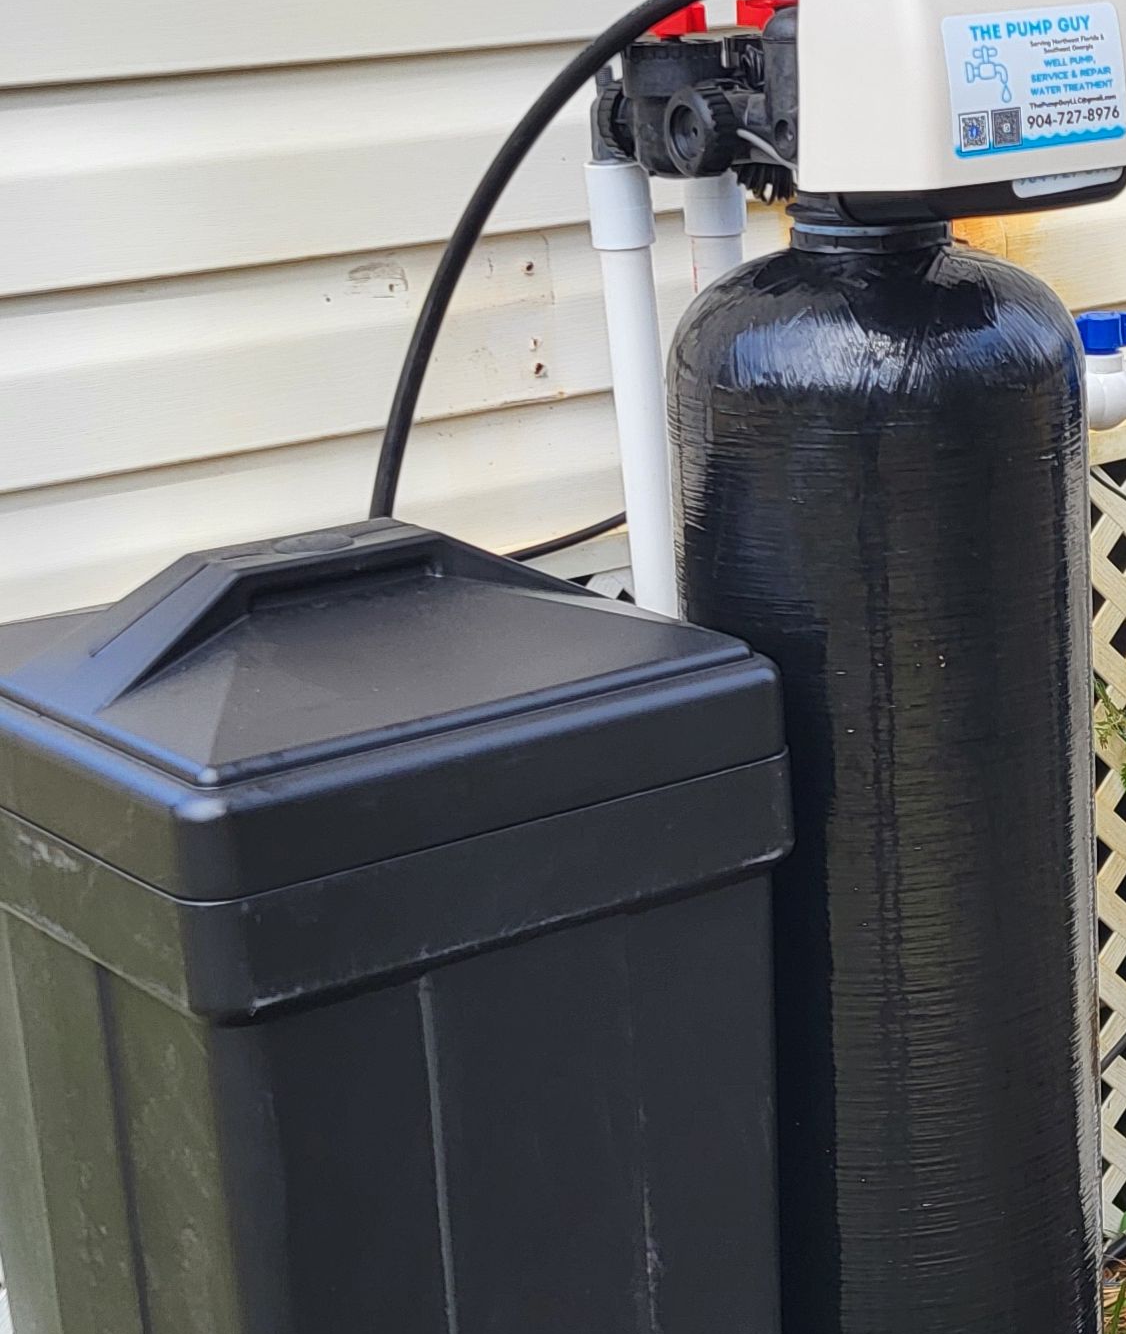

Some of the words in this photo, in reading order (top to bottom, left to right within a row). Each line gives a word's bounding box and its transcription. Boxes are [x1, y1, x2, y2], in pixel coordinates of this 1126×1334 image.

[969, 24, 1001, 42] THE
[1006, 18, 1052, 38] PUMP
[1057, 15, 1090, 33] GUY
[1030, 40, 1051, 48] Serving
[1052, 37, 1079, 46] Northeast
[1080, 34, 1099, 42] Florida
[1043, 58, 1067, 67] WELL
[1030, 70, 1069, 83] SERVICE
[1071, 69, 1078, 79] &
[1080, 66, 1111, 78] REPAIR
[1030, 85, 1062, 97] WATER
[1063, 79, 1113, 92] TREATMENT
[1027, 105, 1120, 129] 904-727-8976
